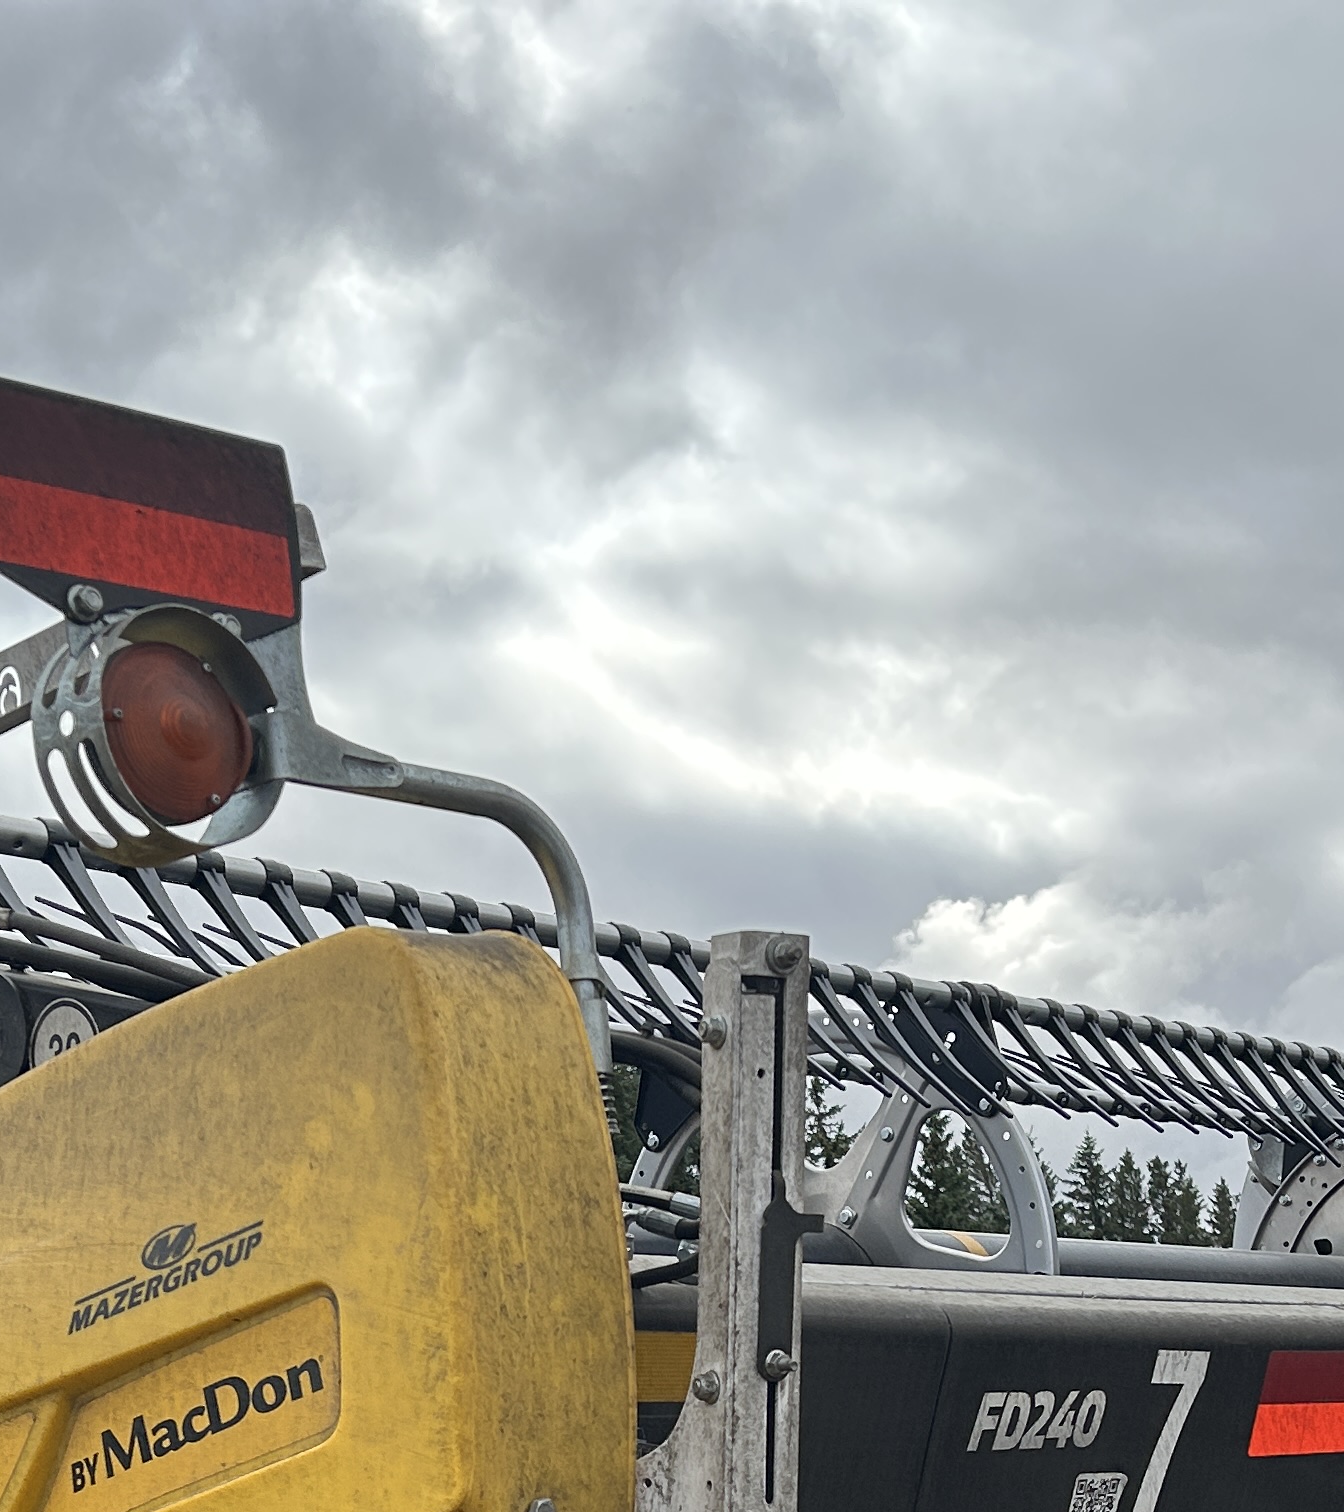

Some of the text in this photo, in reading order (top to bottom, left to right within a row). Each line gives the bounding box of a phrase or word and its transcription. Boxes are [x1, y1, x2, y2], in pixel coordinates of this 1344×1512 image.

[67, 1231, 263, 1335] MAZERGROUP
[71, 1356, 324, 1494] BY MacDon
[967, 1389, 1107, 1452] FD240
